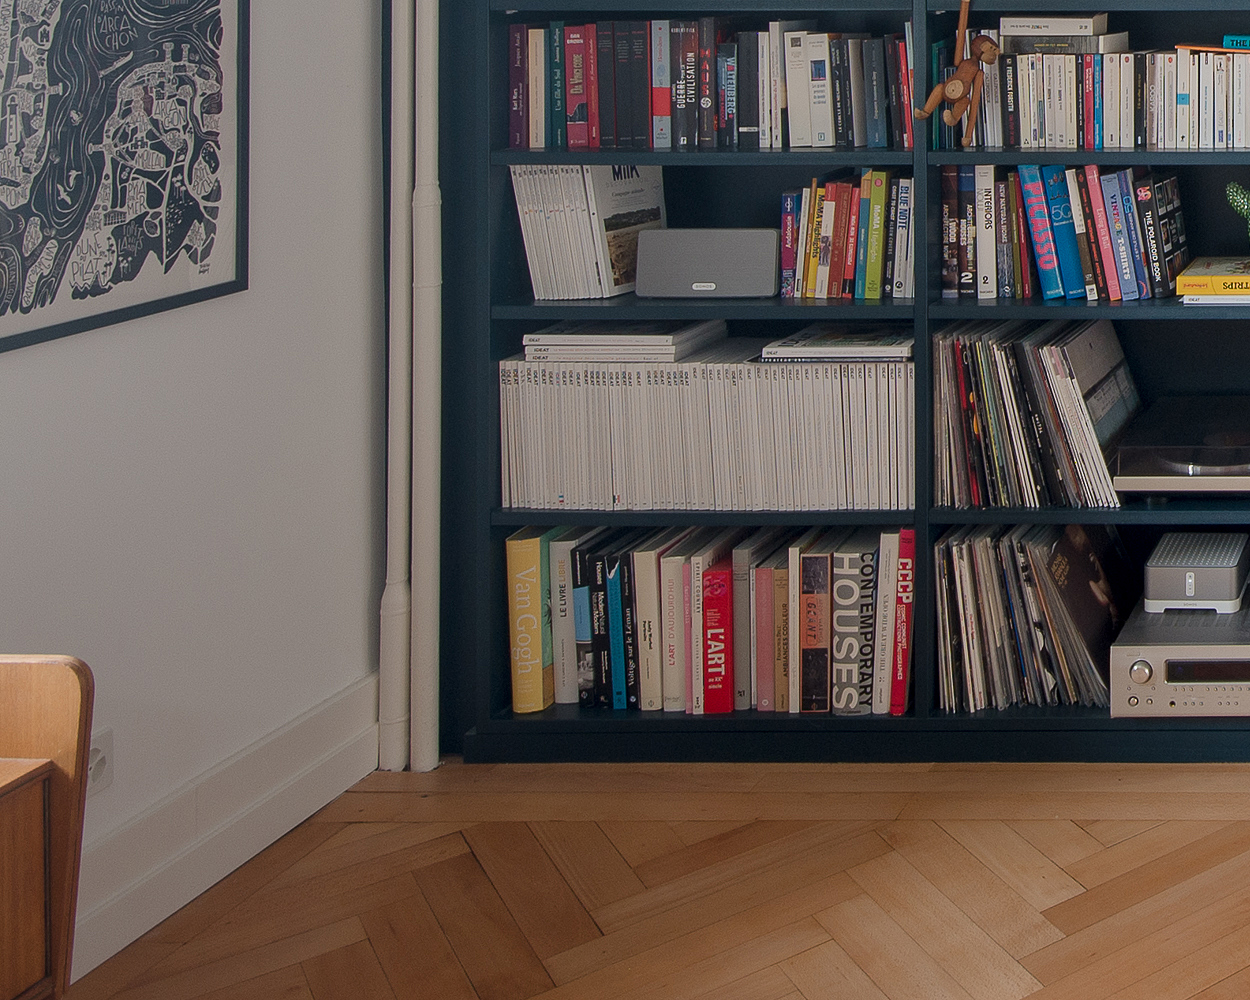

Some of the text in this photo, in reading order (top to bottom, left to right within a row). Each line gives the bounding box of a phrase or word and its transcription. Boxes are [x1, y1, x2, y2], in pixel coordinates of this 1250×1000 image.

[572, 54, 582, 67] CODE
[1230, 39, 1247, 47] THE
[677, 80, 686, 108] GUERRE
[686, 52, 695, 103] CIVILISATION
[727, 57, 735, 115] WALTENBERG
[816, 194, 825, 219] MoMA
[873, 205, 881, 229] MoMA
[898, 185, 910, 230] BLUE NOTE
[984, 188, 992, 230] INTERIORS
[1024, 181, 1059, 271] PICASSO
[1109, 194, 1123, 237] VINTAGE
[1123, 196, 1133, 213] 50
[785, 215, 793, 248] Andalousie
[1147, 226, 1159, 261] POLAROID
[1153, 262, 1162, 282] BOOK
[960, 271, 972, 283] 2
[1222, 281, 1250, 290] TRIPS
[558, 559, 567, 617] LE LIVRE LIBRE
[595, 562, 603, 584] Houses
[897, 557, 913, 603] CCCP
[512, 566, 539, 675] Van Gogh
[667, 578, 676, 666] L'ART D'AUJOURD'HUI
[832, 552, 860, 709] HOUSES
[859, 552, 874, 707] CONTEMPORARY
[628, 659, 637, 687] Voltige
[706, 628, 725, 675] L'ART
